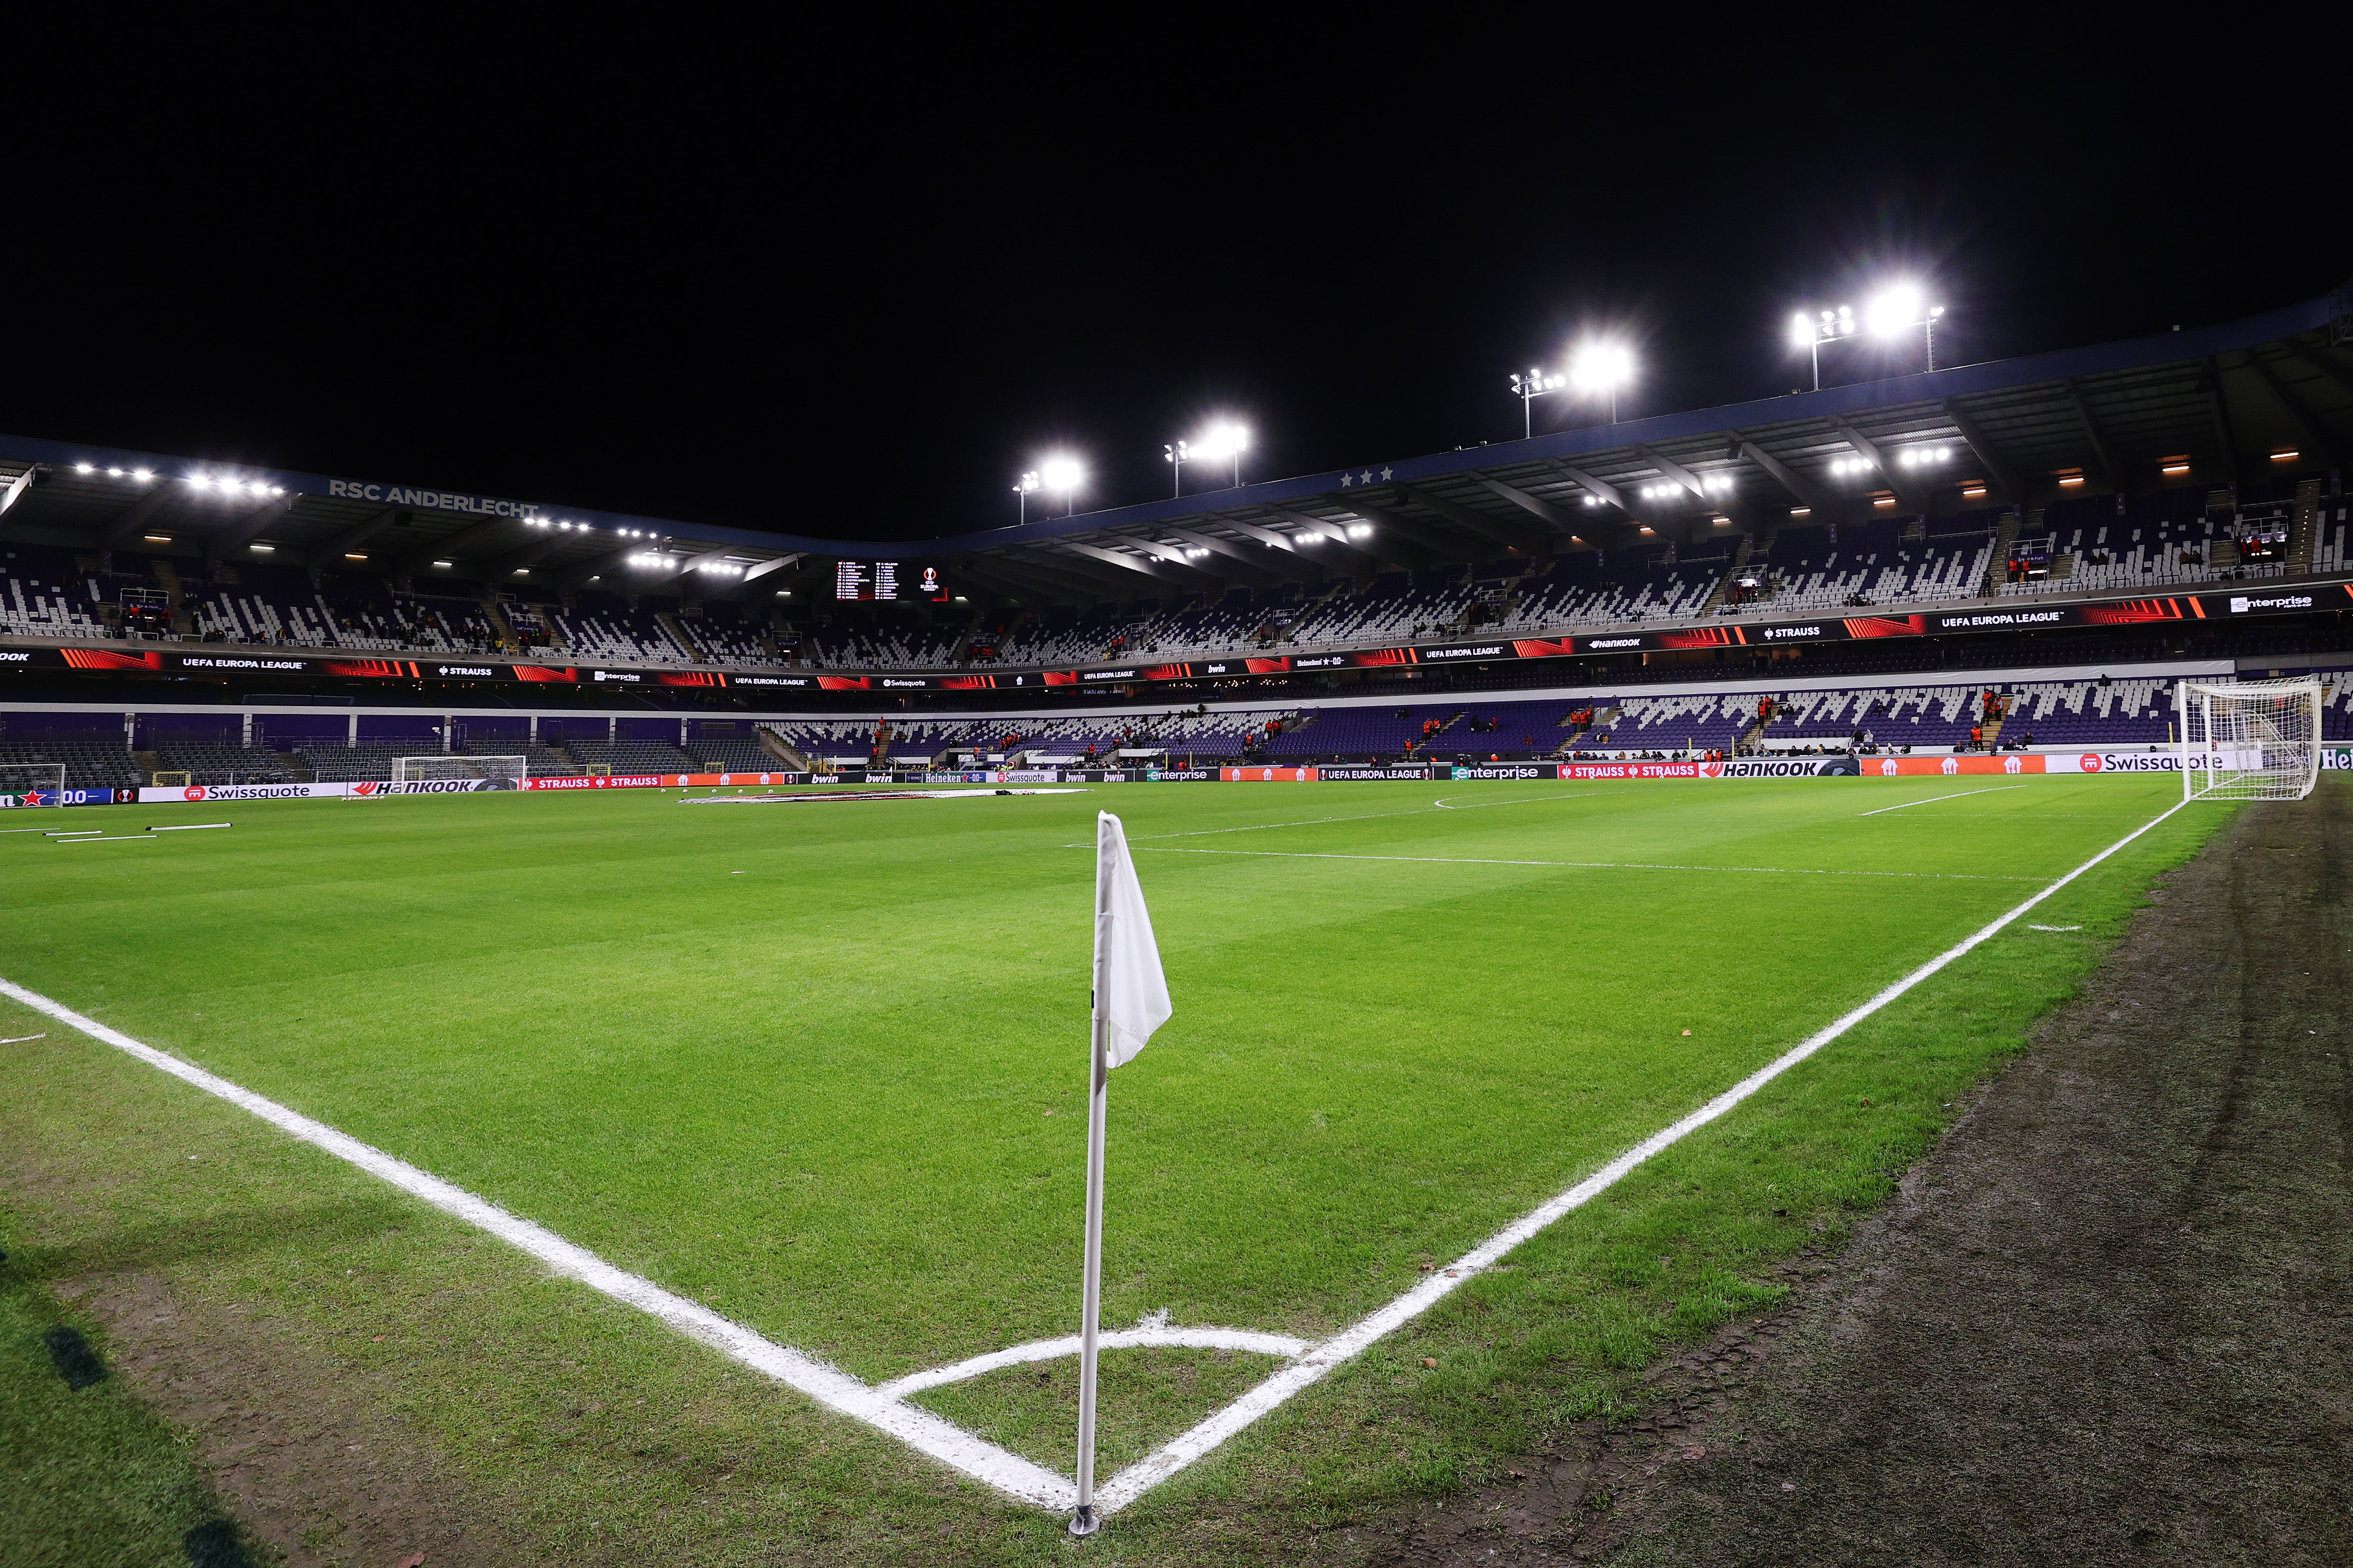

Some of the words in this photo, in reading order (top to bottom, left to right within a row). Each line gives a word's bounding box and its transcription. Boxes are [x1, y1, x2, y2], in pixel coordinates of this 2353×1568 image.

[329, 480, 381, 500] RSC
[386, 487, 539, 519] ANDERLECHT
[2236, 596, 2312, 608] enterprise
[1942, 617, 1970, 627] UEFA
[1972, 614, 2014, 625] EUROPA
[1775, 626, 1820, 637] STRAUSS
[1446, 649, 1472, 657] EUROPA
[216, 660, 259, 668] EUROPA
[1297, 658, 1322, 667] Heineken
[449, 667, 492, 676] STRAUSS
[1208, 664, 1226, 674] bwin
[891, 679, 926, 688] Swissquote
[2105, 754, 2223, 771] Swissquote
[1149, 769, 1208, 782] enterprise
[1329, 770, 1351, 780] UEFA
[1352, 770, 1385, 779] EUROPA
[1387, 769, 1421, 779] LEAGUE
[1456, 765, 1538, 780] enterprise
[1575, 766, 1625, 777] STRAUSS
[1642, 765, 1694, 776] STRAUSS
[539, 777, 590, 788] STRAUSS
[611, 777, 658, 786] STRAUSS
[811, 773, 839, 784] bwin
[865, 773, 893, 784] bwin
[926, 773, 961, 783] Heineken
[1006, 771, 1045, 783] Swissquote
[1065, 772, 1086, 783] bwin
[1103, 771, 1125, 783] bwin
[208, 784, 310, 799] Swissquote
